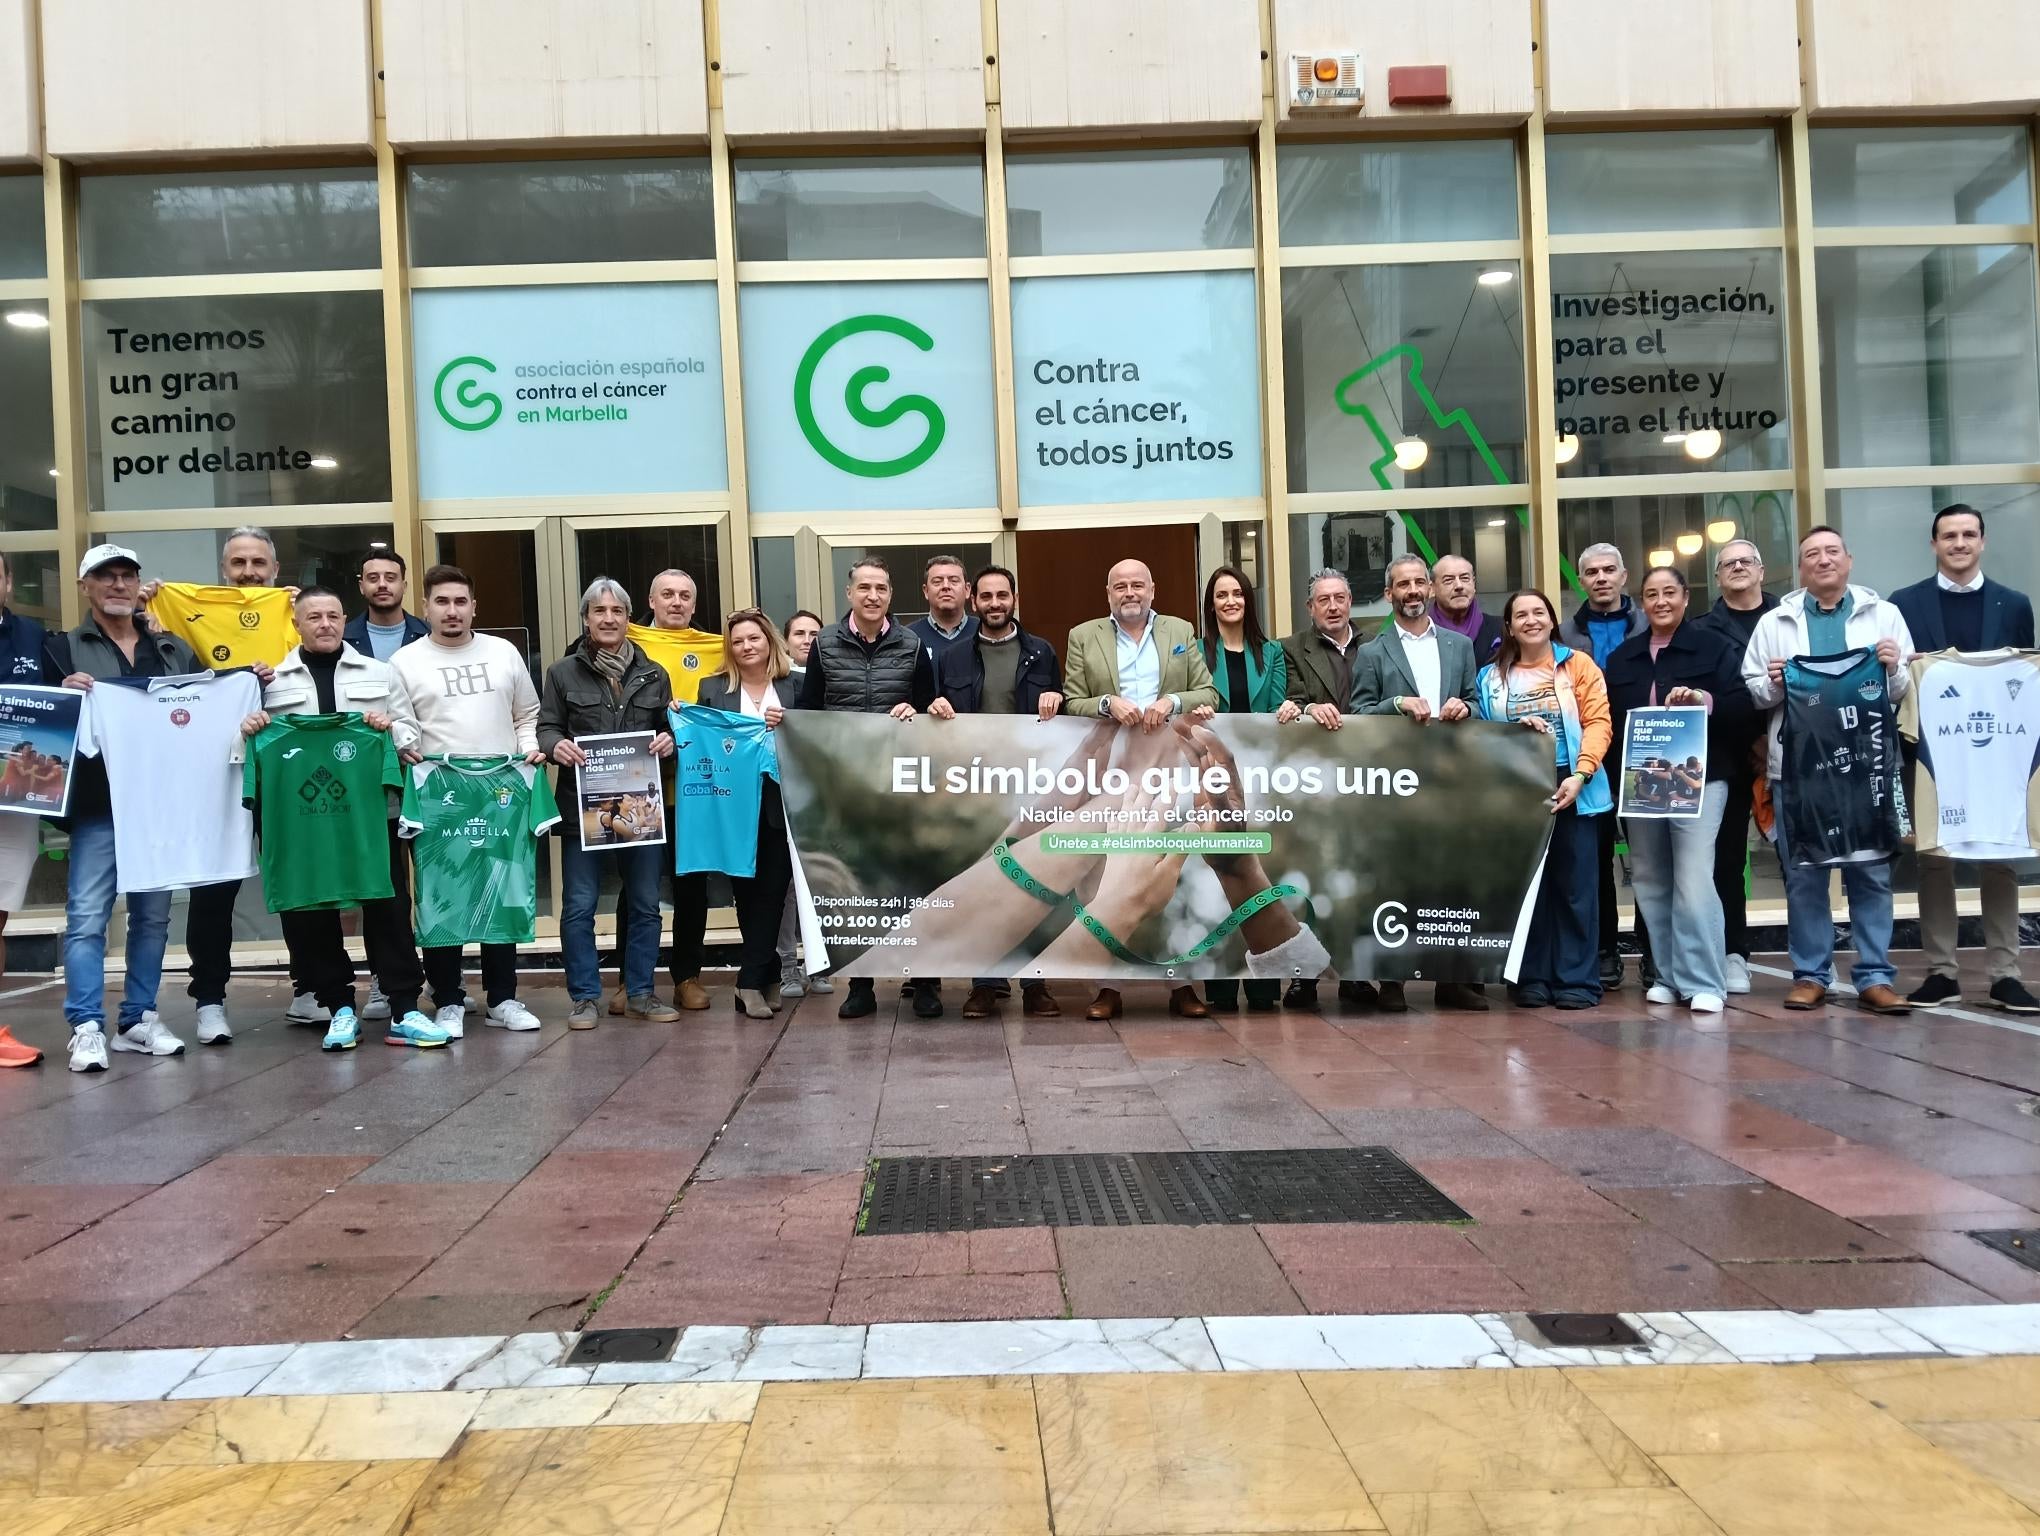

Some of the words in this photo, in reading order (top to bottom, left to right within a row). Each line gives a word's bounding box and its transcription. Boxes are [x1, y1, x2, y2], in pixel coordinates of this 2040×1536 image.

[1554, 286, 1775, 321] Investigación,
[107, 328, 265, 354] Tenemos
[1555, 336, 1628, 364] para
[1636, 329, 1667, 354] el
[515, 359, 614, 378] asociación
[620, 357, 705, 379] española
[1033, 358, 1140, 385] Contra
[109, 373, 151, 395] un
[161, 368, 238, 400] gran
[516, 383, 577, 400] contra
[582, 382, 598, 399] el
[603, 381, 667, 398] cáncer
[1555, 369, 1699, 403] presente
[1708, 372, 1726, 399] y
[517, 408, 540, 423] en
[545, 404, 628, 422] Marbella
[1035, 400, 1066, 426] el
[1073, 397, 1187, 424] cáncer,
[110, 406, 236, 435] camino
[1557, 412, 1631, 443] para
[1638, 407, 1669, 433] el
[1676, 405, 1778, 432] futuro
[1036, 439, 1128, 467] todos
[1132, 436, 1234, 469] juntos
[112, 453, 170, 482] por
[178, 445, 312, 473] delante
[0, 705, 13, 713] ue
[5, 696, 55, 711] símbolo
[12, 714, 36, 724] une
[1634, 719, 1644, 728] El
[1645, 718, 1685, 728] símbolo
[1838, 705, 1859, 730] 19
[1633, 727, 1653, 736] que
[1938, 721, 2027, 737] MARBELLA
[1632, 734, 1651, 742] nos
[1652, 734, 1672, 742] une
[584, 749, 594, 758] El
[595, 745, 636, 757] símbolo
[585, 757, 605, 766] que
[585, 764, 604, 773] nos
[605, 762, 625, 771] une
[685, 764, 731, 773] MARBELLA
[1815, 752, 1868, 771] MARBELLA
[891, 756, 936, 794] El
[945, 755, 1130, 796] símbolo
[1141, 765, 1230, 804] que
[1243, 765, 1323, 795] nos
[1336, 766, 1420, 797] une
[1019, 806, 1076, 823] Nadie
[1079, 806, 1159, 824] enfrenta
[1163, 806, 1182, 822] el
[1186, 805, 1250, 823] cáncer
[1254, 805, 1294, 823] solo
[441, 826, 510, 838] MARBELLA
[1049, 833, 1088, 849] Únete
[1091, 839, 1100, 849] a
[813, 895, 879, 909] Disponibles
[880, 896, 901, 909] 24h
[909, 897, 929, 909] 365
[932, 897, 955, 909] días
[847, 915, 878, 928] 100
[881, 913, 912, 930] 036
[1416, 906, 1480, 920] asociación
[1416, 920, 1471, 935] española
[821, 934, 918, 946] ontraelcancer.es
[1416, 934, 1456, 946] contra
[1458, 934, 1469, 947] el
[1470, 935, 1511, 948] cáncer
